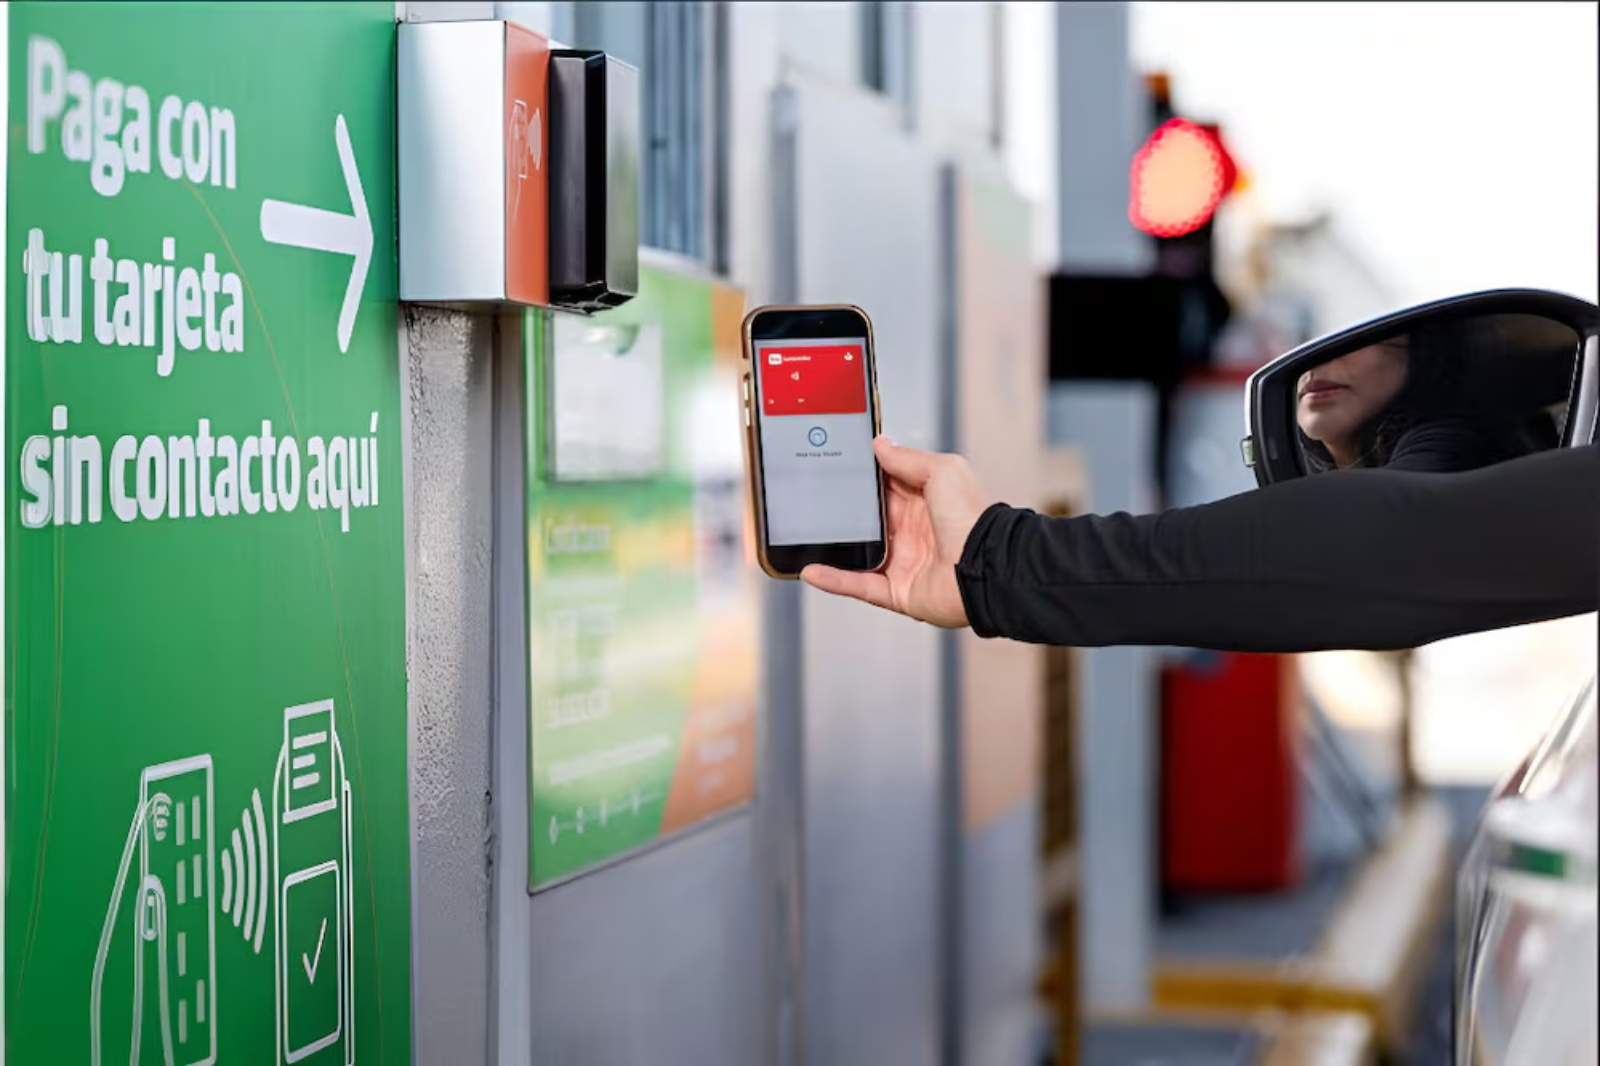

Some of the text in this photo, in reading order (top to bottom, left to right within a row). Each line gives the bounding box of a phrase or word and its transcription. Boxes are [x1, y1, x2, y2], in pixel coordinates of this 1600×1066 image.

[28, 34, 236, 196] Paga con
[23, 227, 244, 377] tu tarjeta
[20, 404, 378, 532] sin contacto aquí
